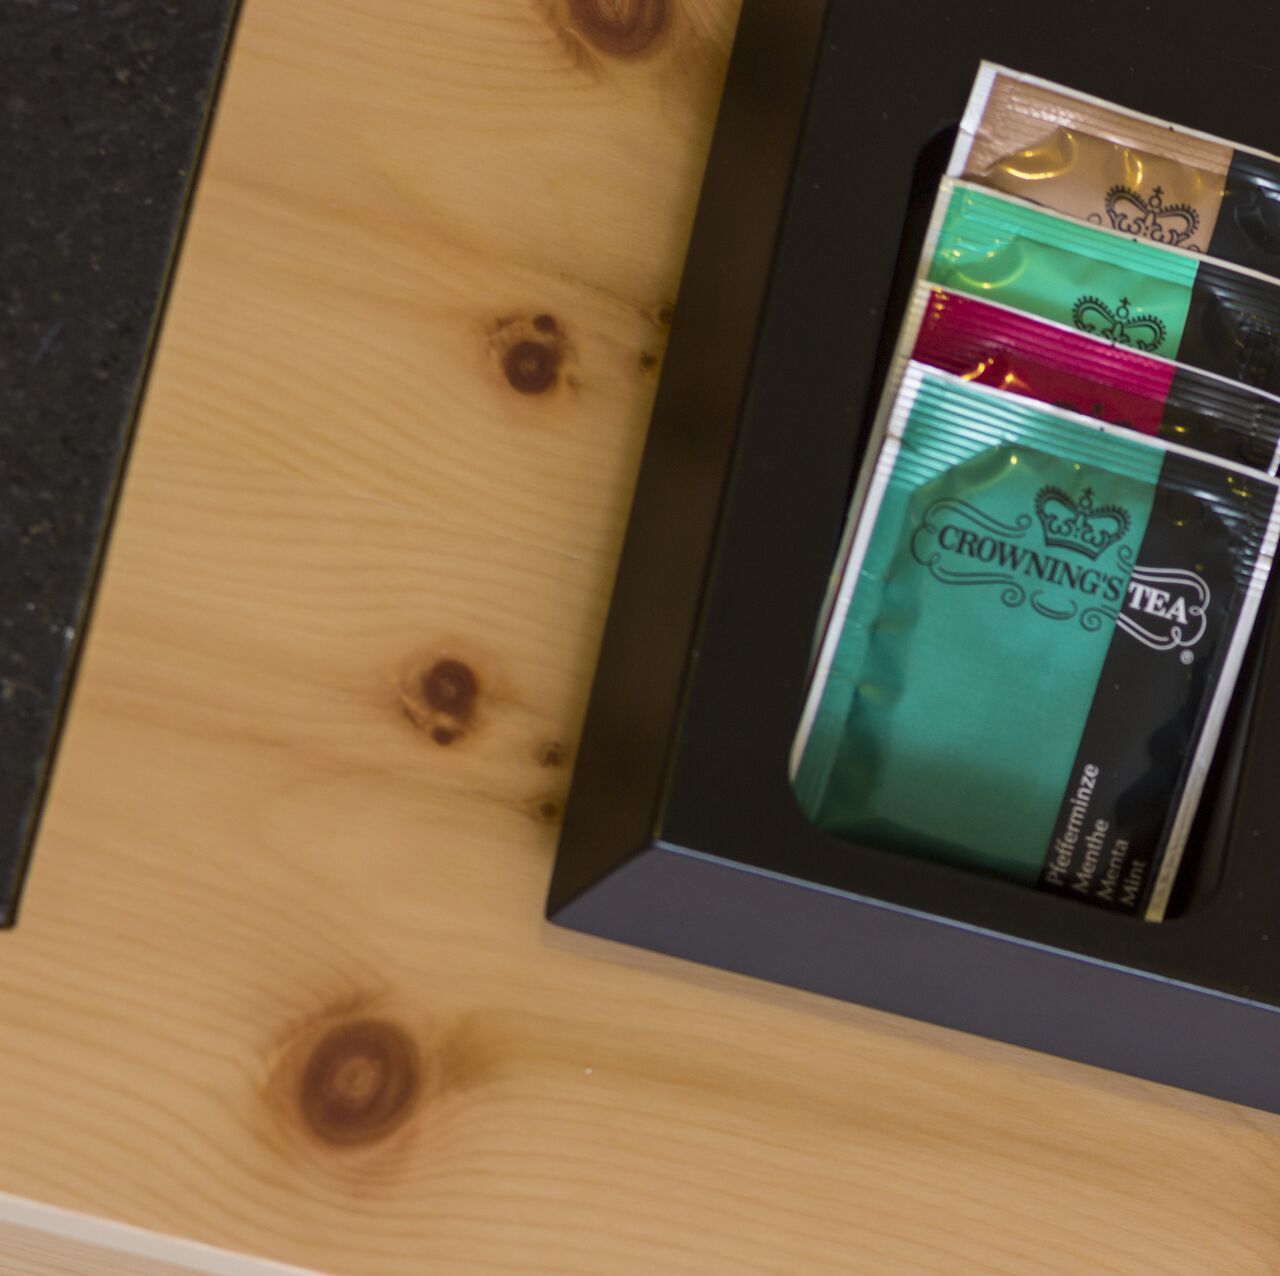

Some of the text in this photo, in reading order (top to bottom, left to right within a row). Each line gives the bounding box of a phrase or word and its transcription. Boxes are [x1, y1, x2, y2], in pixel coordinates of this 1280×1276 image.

[938, 525, 1189, 625] CROWNING'S TEA
[1047, 763, 1100, 886] Pfefferminze
[1072, 819, 1110, 893] Menthe
[1096, 839, 1130, 901] Menta
[1120, 859, 1147, 907] Mint
